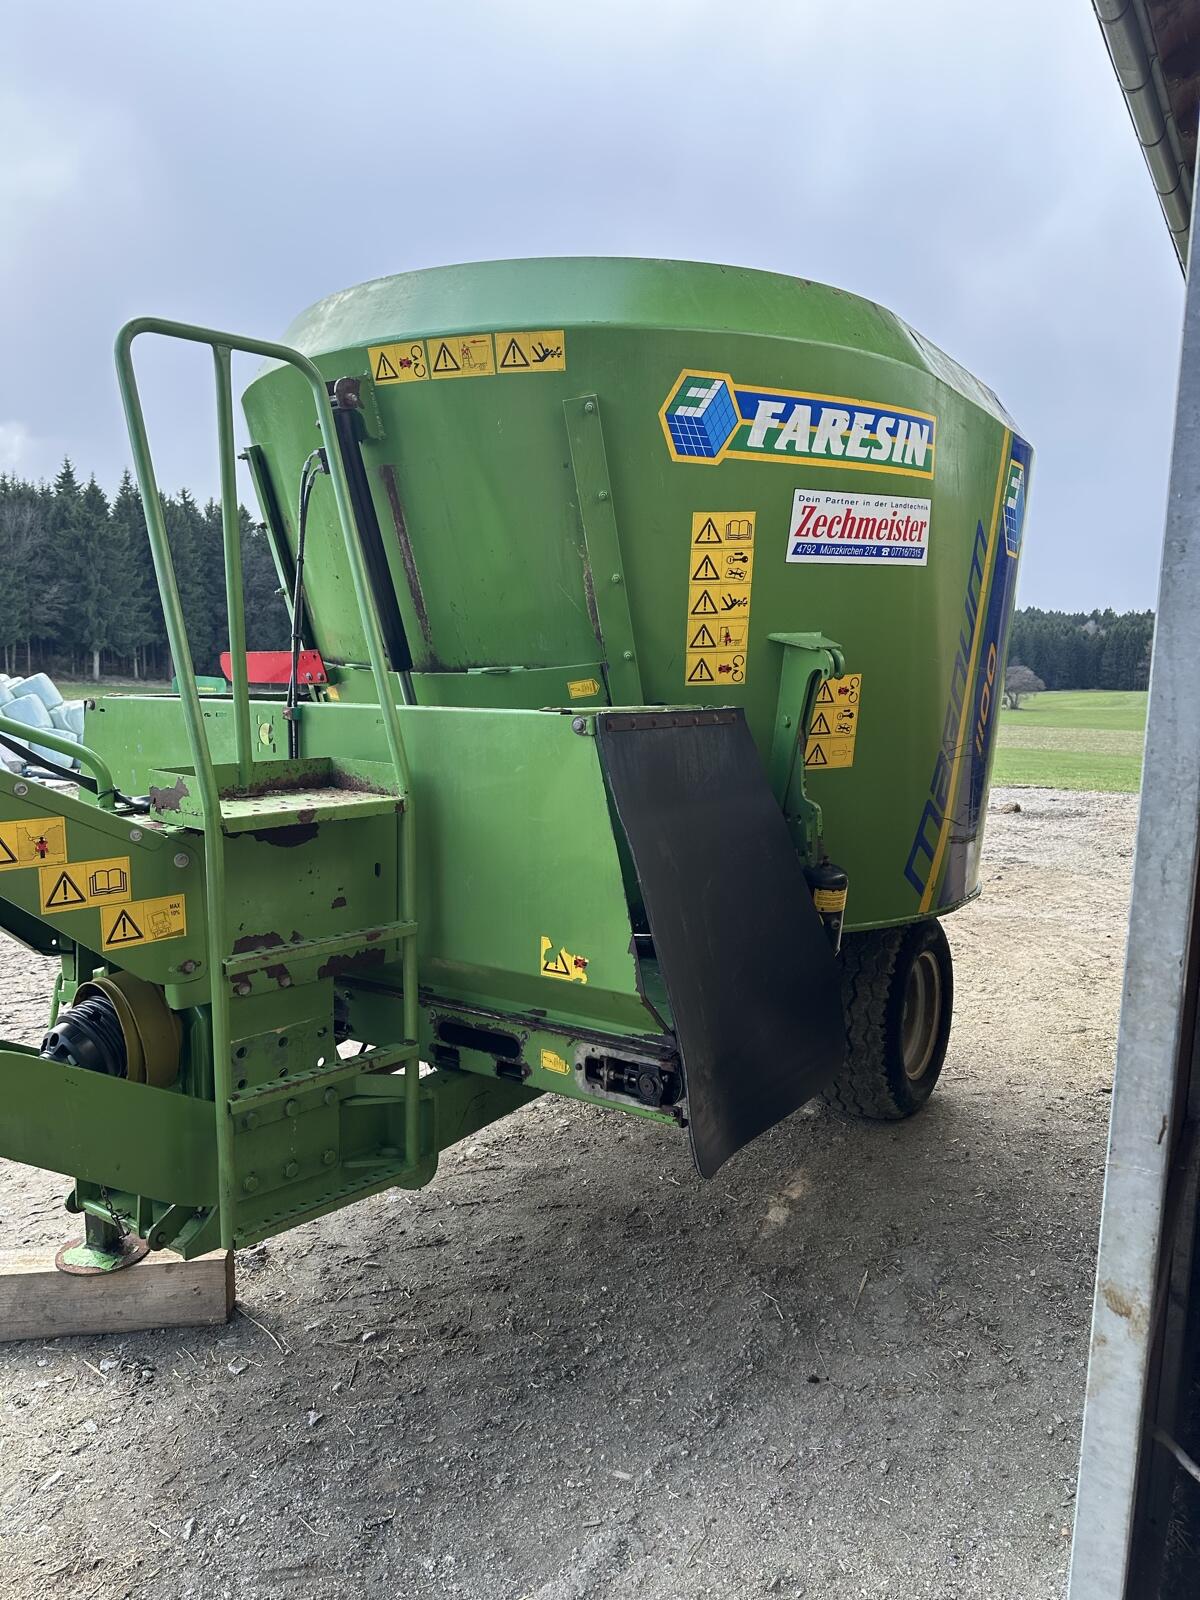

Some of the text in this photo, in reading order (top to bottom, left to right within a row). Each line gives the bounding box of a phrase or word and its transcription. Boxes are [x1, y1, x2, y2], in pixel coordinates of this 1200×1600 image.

[747, 400, 930, 467] FARESIN
[798, 494, 821, 503] Dein
[825, 496, 859, 506] Partner
[891, 501, 929, 511] Landtechnik
[794, 505, 927, 543] Zechmeister
[797, 544, 816, 554] 4792
[819, 545, 863, 556] Münzkirchen
[865, 546, 877, 556] 274
